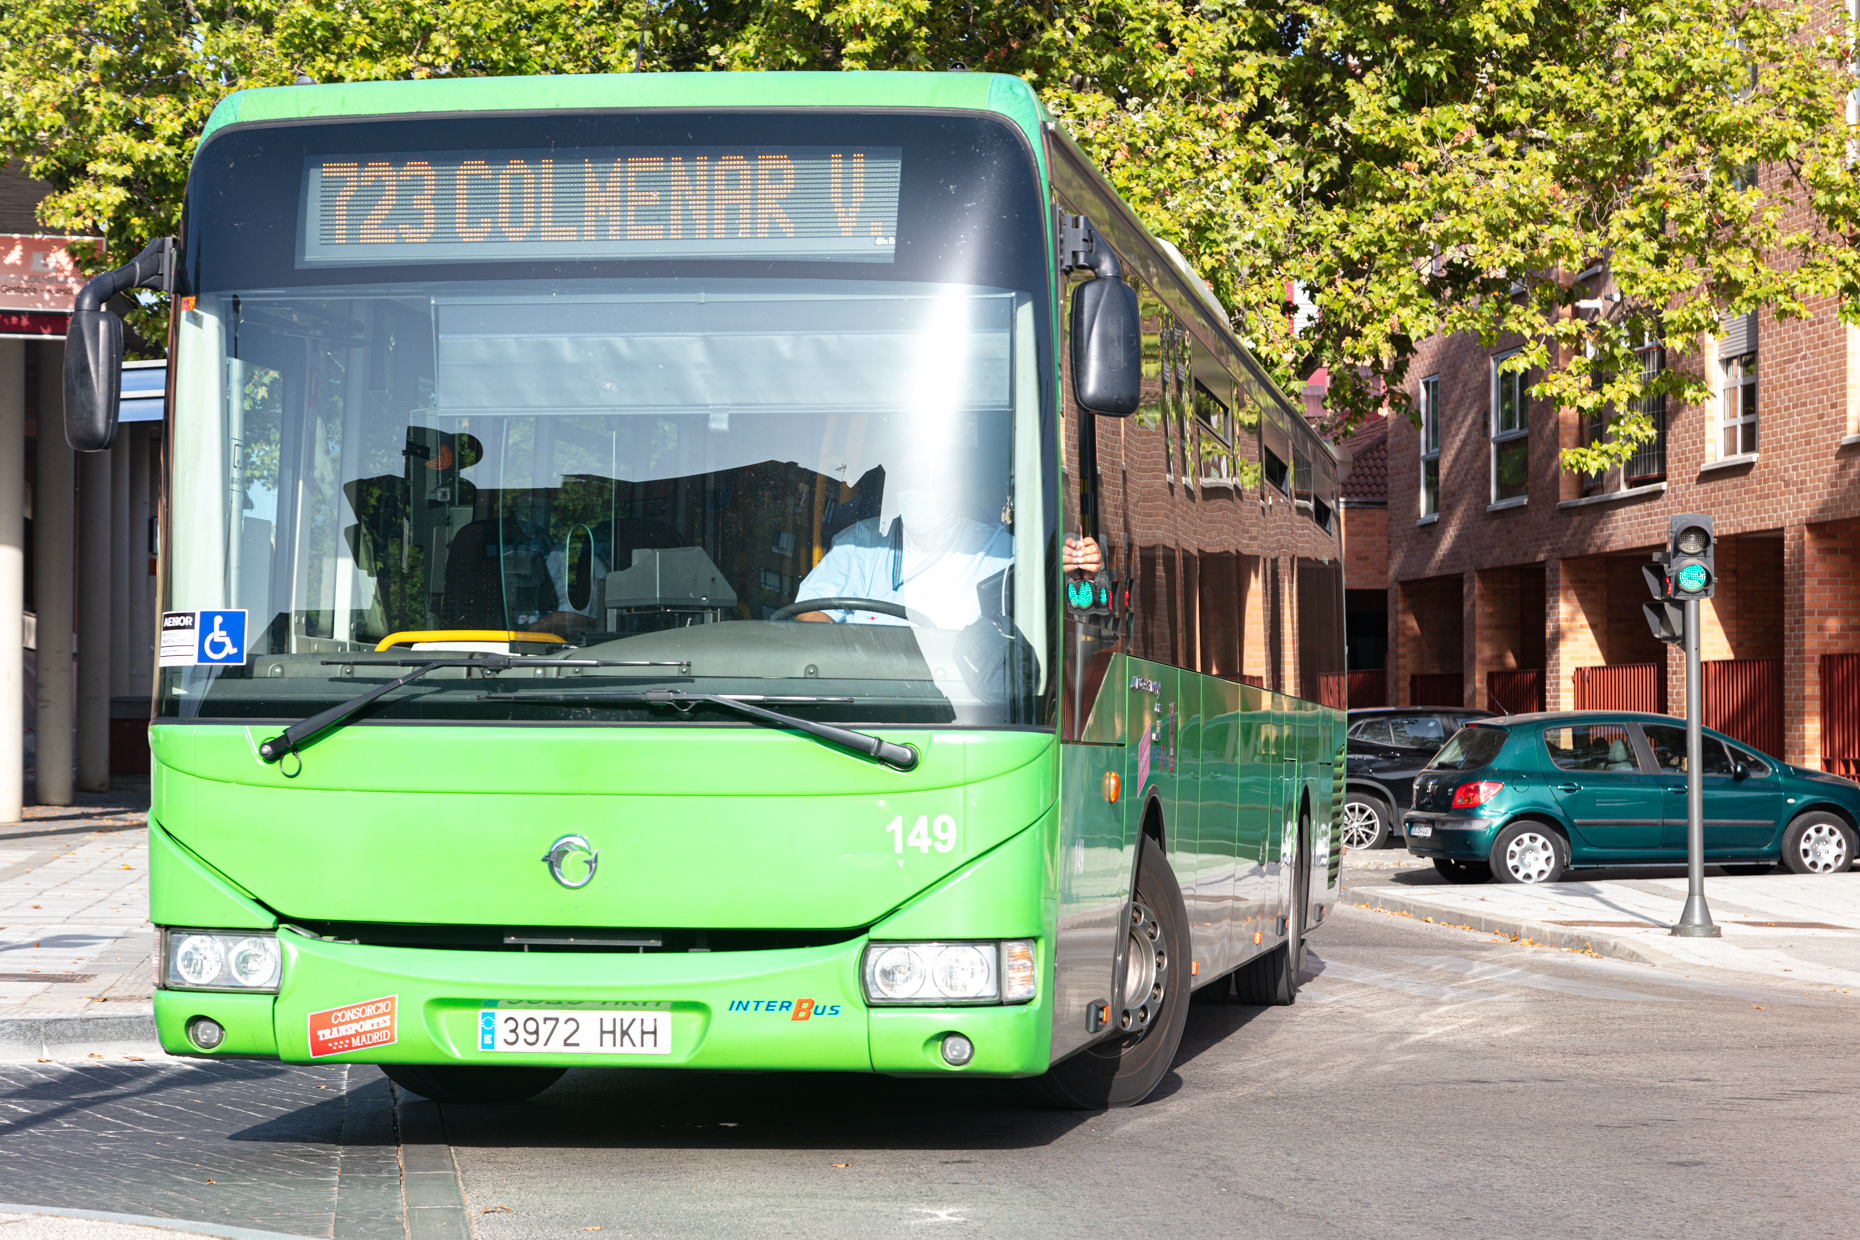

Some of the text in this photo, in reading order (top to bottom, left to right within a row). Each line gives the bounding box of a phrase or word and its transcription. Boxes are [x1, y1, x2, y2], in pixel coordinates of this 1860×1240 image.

[321, 153, 883, 244] 723 COLMENAR V.
[164, 616, 193, 627] AENOR
[886, 814, 957, 854] 149
[331, 1000, 391, 1025] CONSORCIO
[316, 1014, 391, 1042] TRANSPORTES
[351, 1029, 391, 1048] MADRID
[503, 1016, 658, 1048] 3972 HKH
